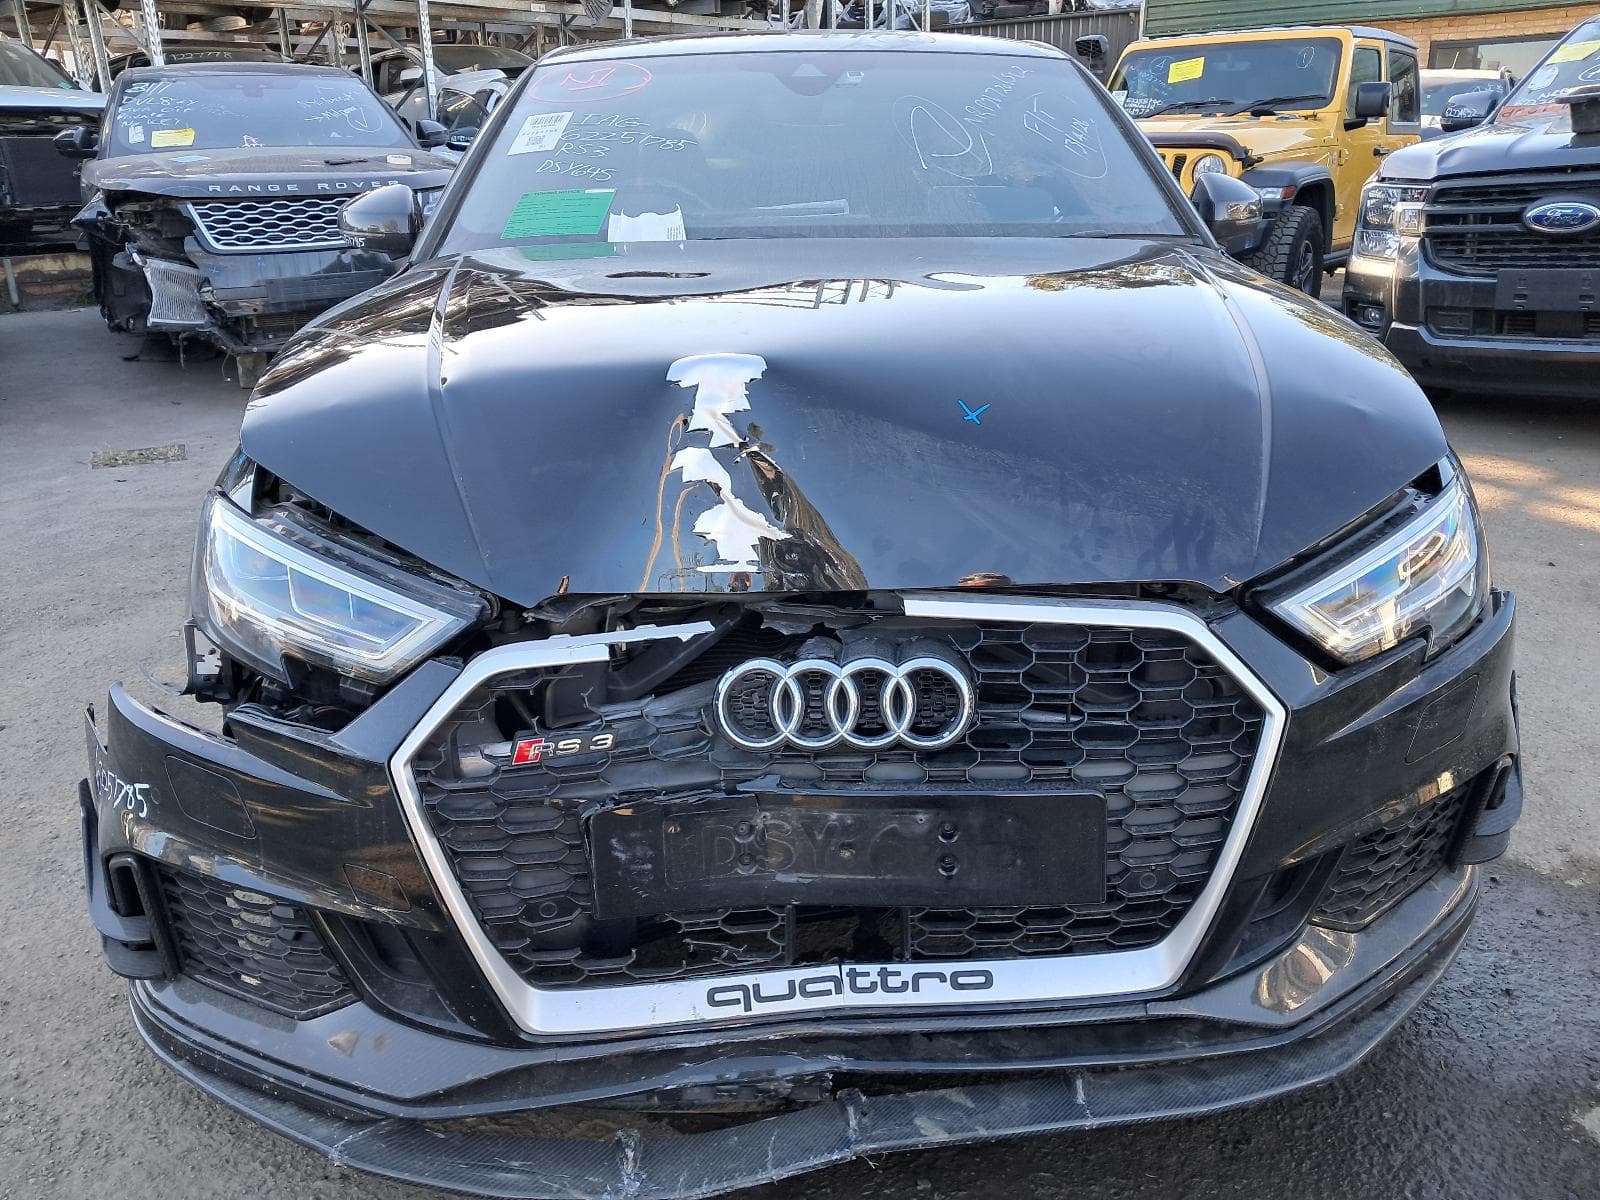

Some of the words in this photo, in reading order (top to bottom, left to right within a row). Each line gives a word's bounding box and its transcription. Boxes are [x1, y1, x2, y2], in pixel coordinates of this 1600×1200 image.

[208, 184, 299, 193] RANGE
[317, 180, 399, 190] ROVER
[1543, 208, 1584, 226] Ford
[706, 966, 994, 1012] quattro
